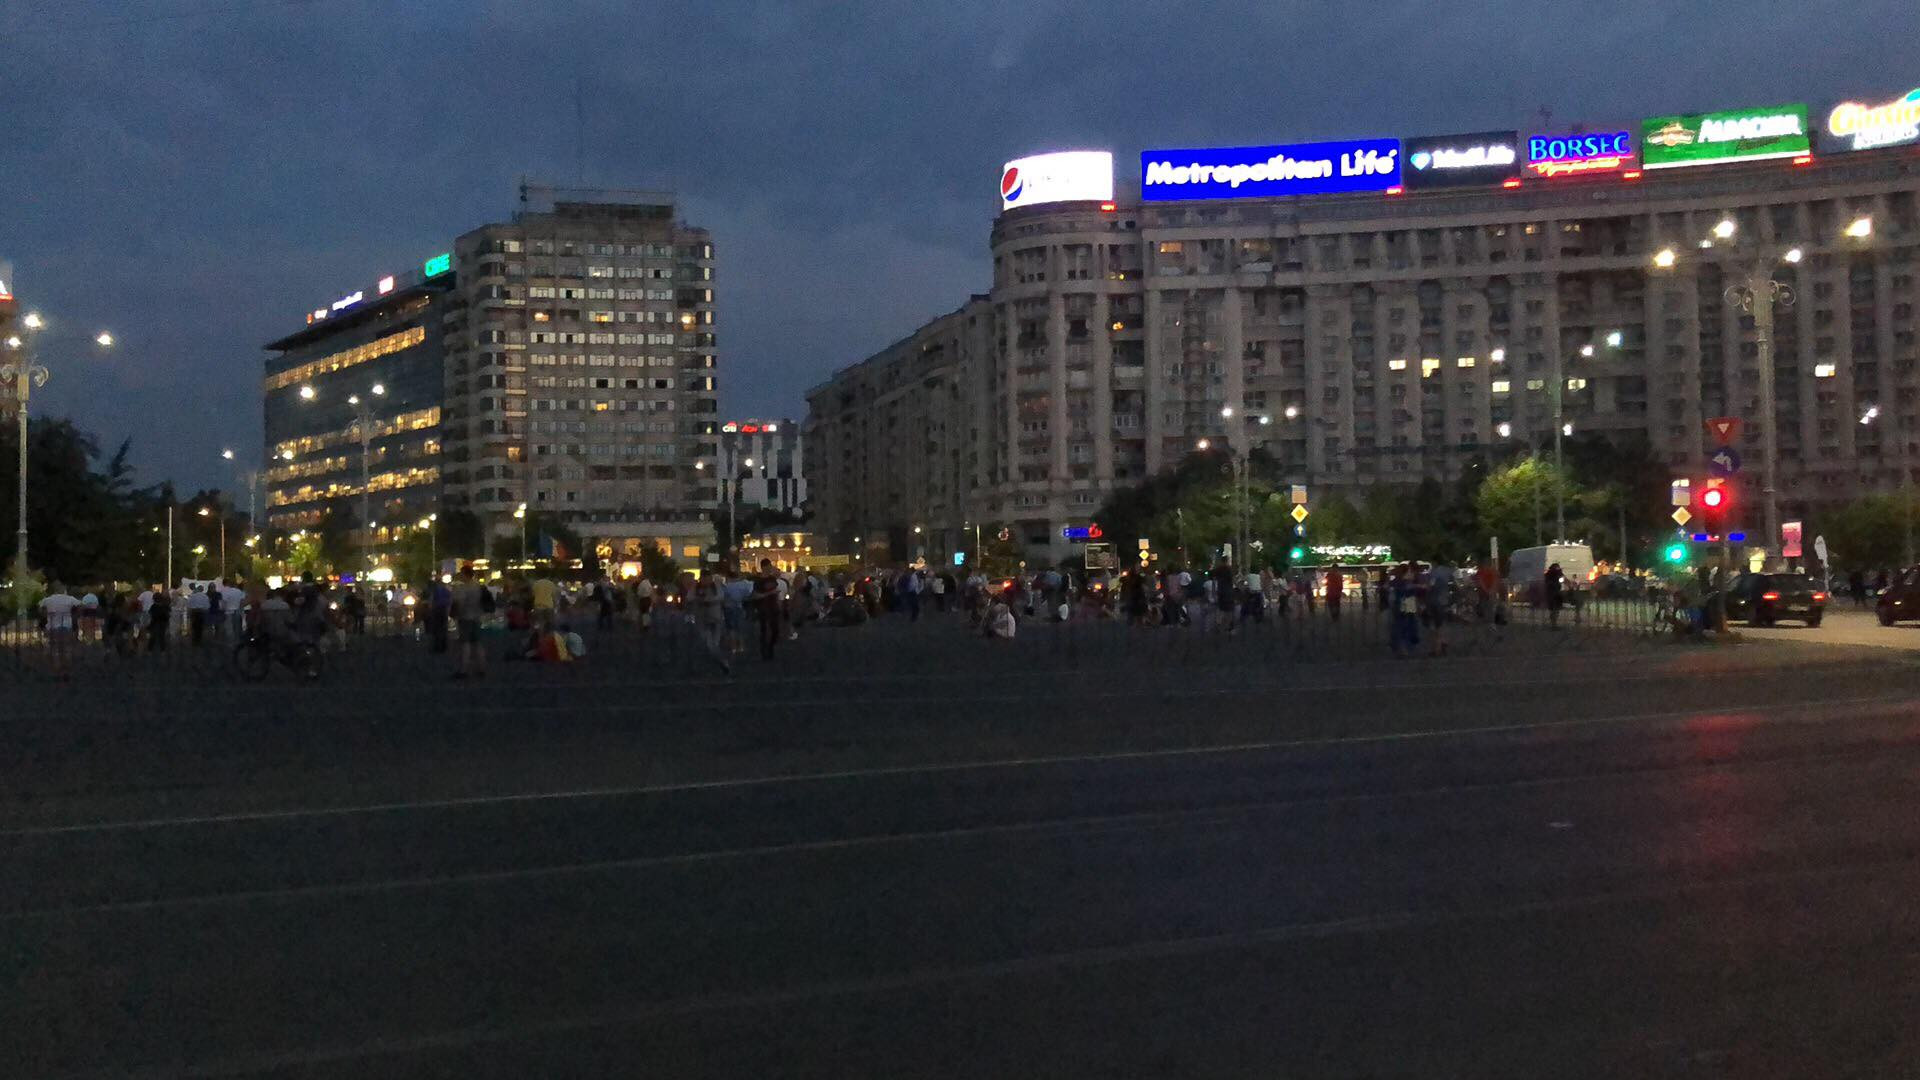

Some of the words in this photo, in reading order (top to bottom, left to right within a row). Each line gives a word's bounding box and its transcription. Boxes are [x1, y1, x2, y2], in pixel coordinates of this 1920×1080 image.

[1530, 133, 1629, 161] BORSEC
[1145, 153, 1333, 188] Metropolitan
[1340, 148, 1397, 177] Life
